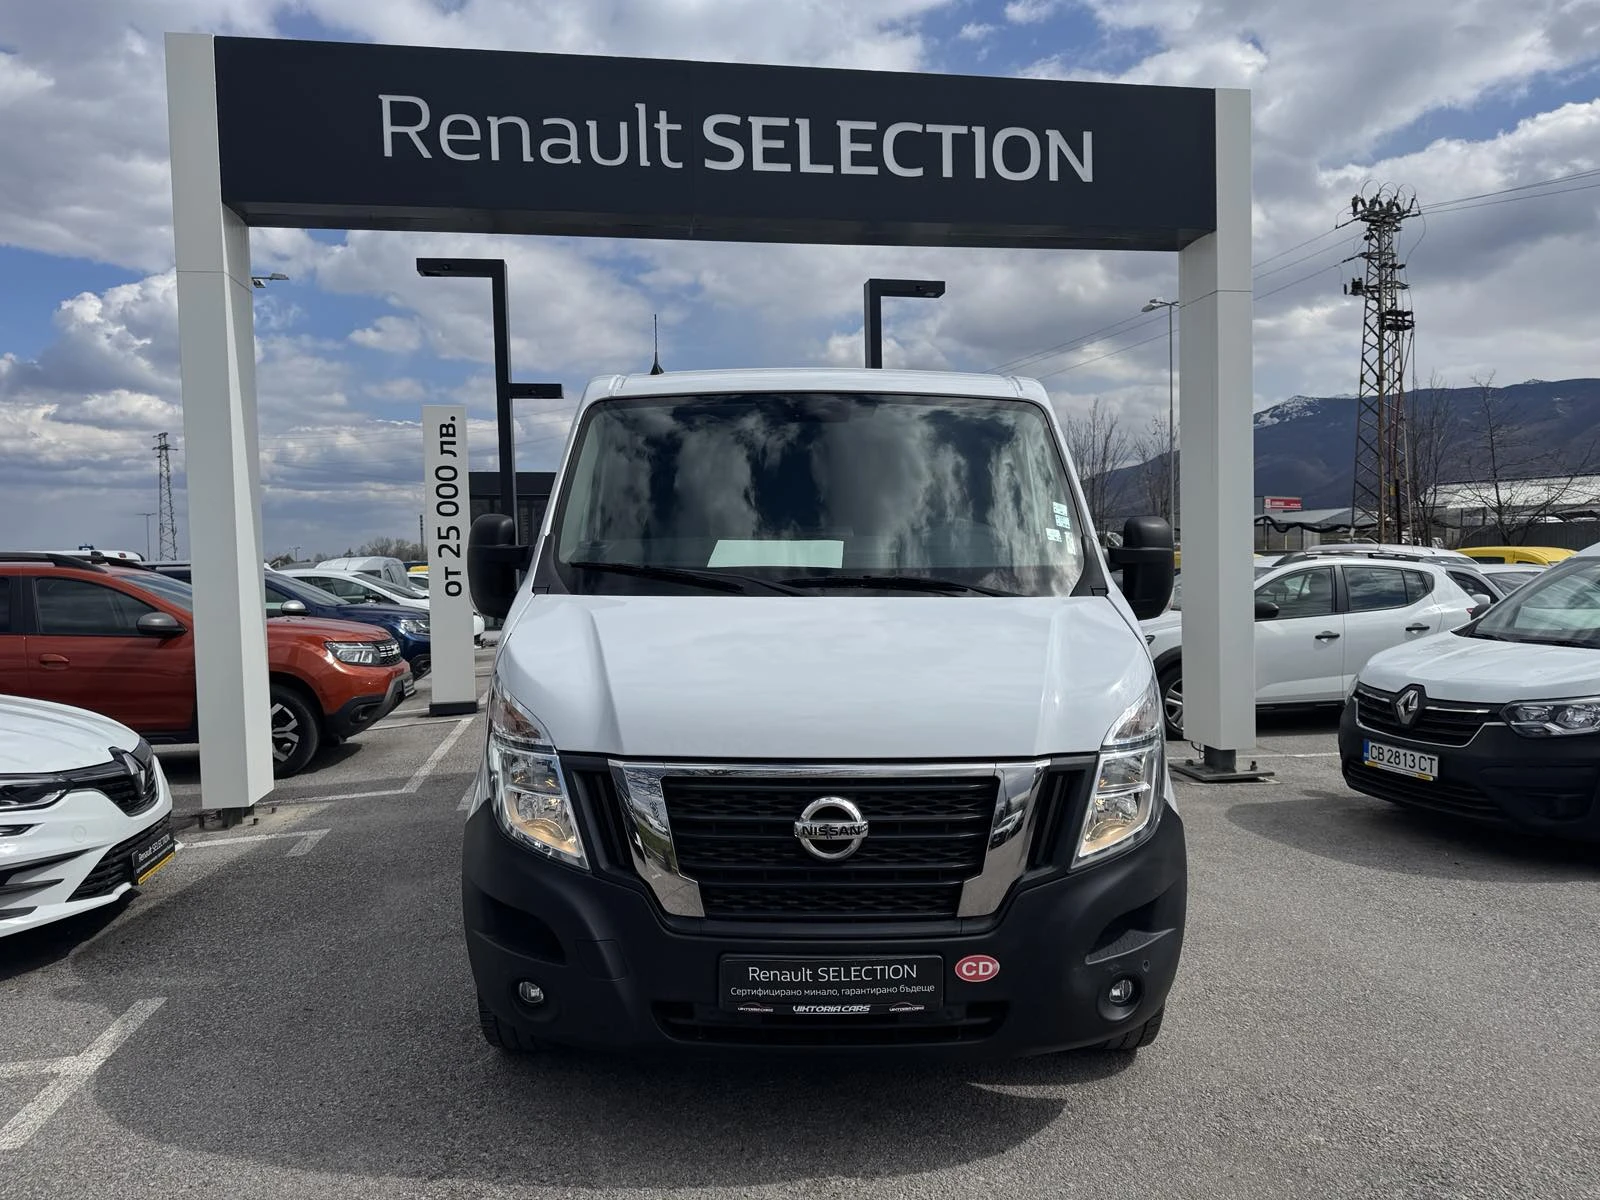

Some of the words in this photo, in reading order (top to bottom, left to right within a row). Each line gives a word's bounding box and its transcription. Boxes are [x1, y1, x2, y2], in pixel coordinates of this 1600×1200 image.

[378, 94, 683, 170] Renault
[702, 113, 1095, 184] SELECTION
[439, 415, 458, 458] лв.
[435, 465, 460, 518] 000
[438, 525, 461, 560] 25
[444, 566, 463, 598] от
[1387, 749, 1416, 769] 2813
[801, 825, 861, 837] NISSAN
[748, 966, 812, 983] Renault
[818, 964, 918, 982] SELECTION
[961, 961, 994, 976] CD
[730, 987, 802, 998] Сертифицирано
[803, 988, 840, 998] минало,
[841, 986, 898, 997] гарантирано
[899, 984, 936, 994] бъдеще
[792, 1005, 841, 1013] VIKTORIA
[841, 1004, 871, 1013] CARS
